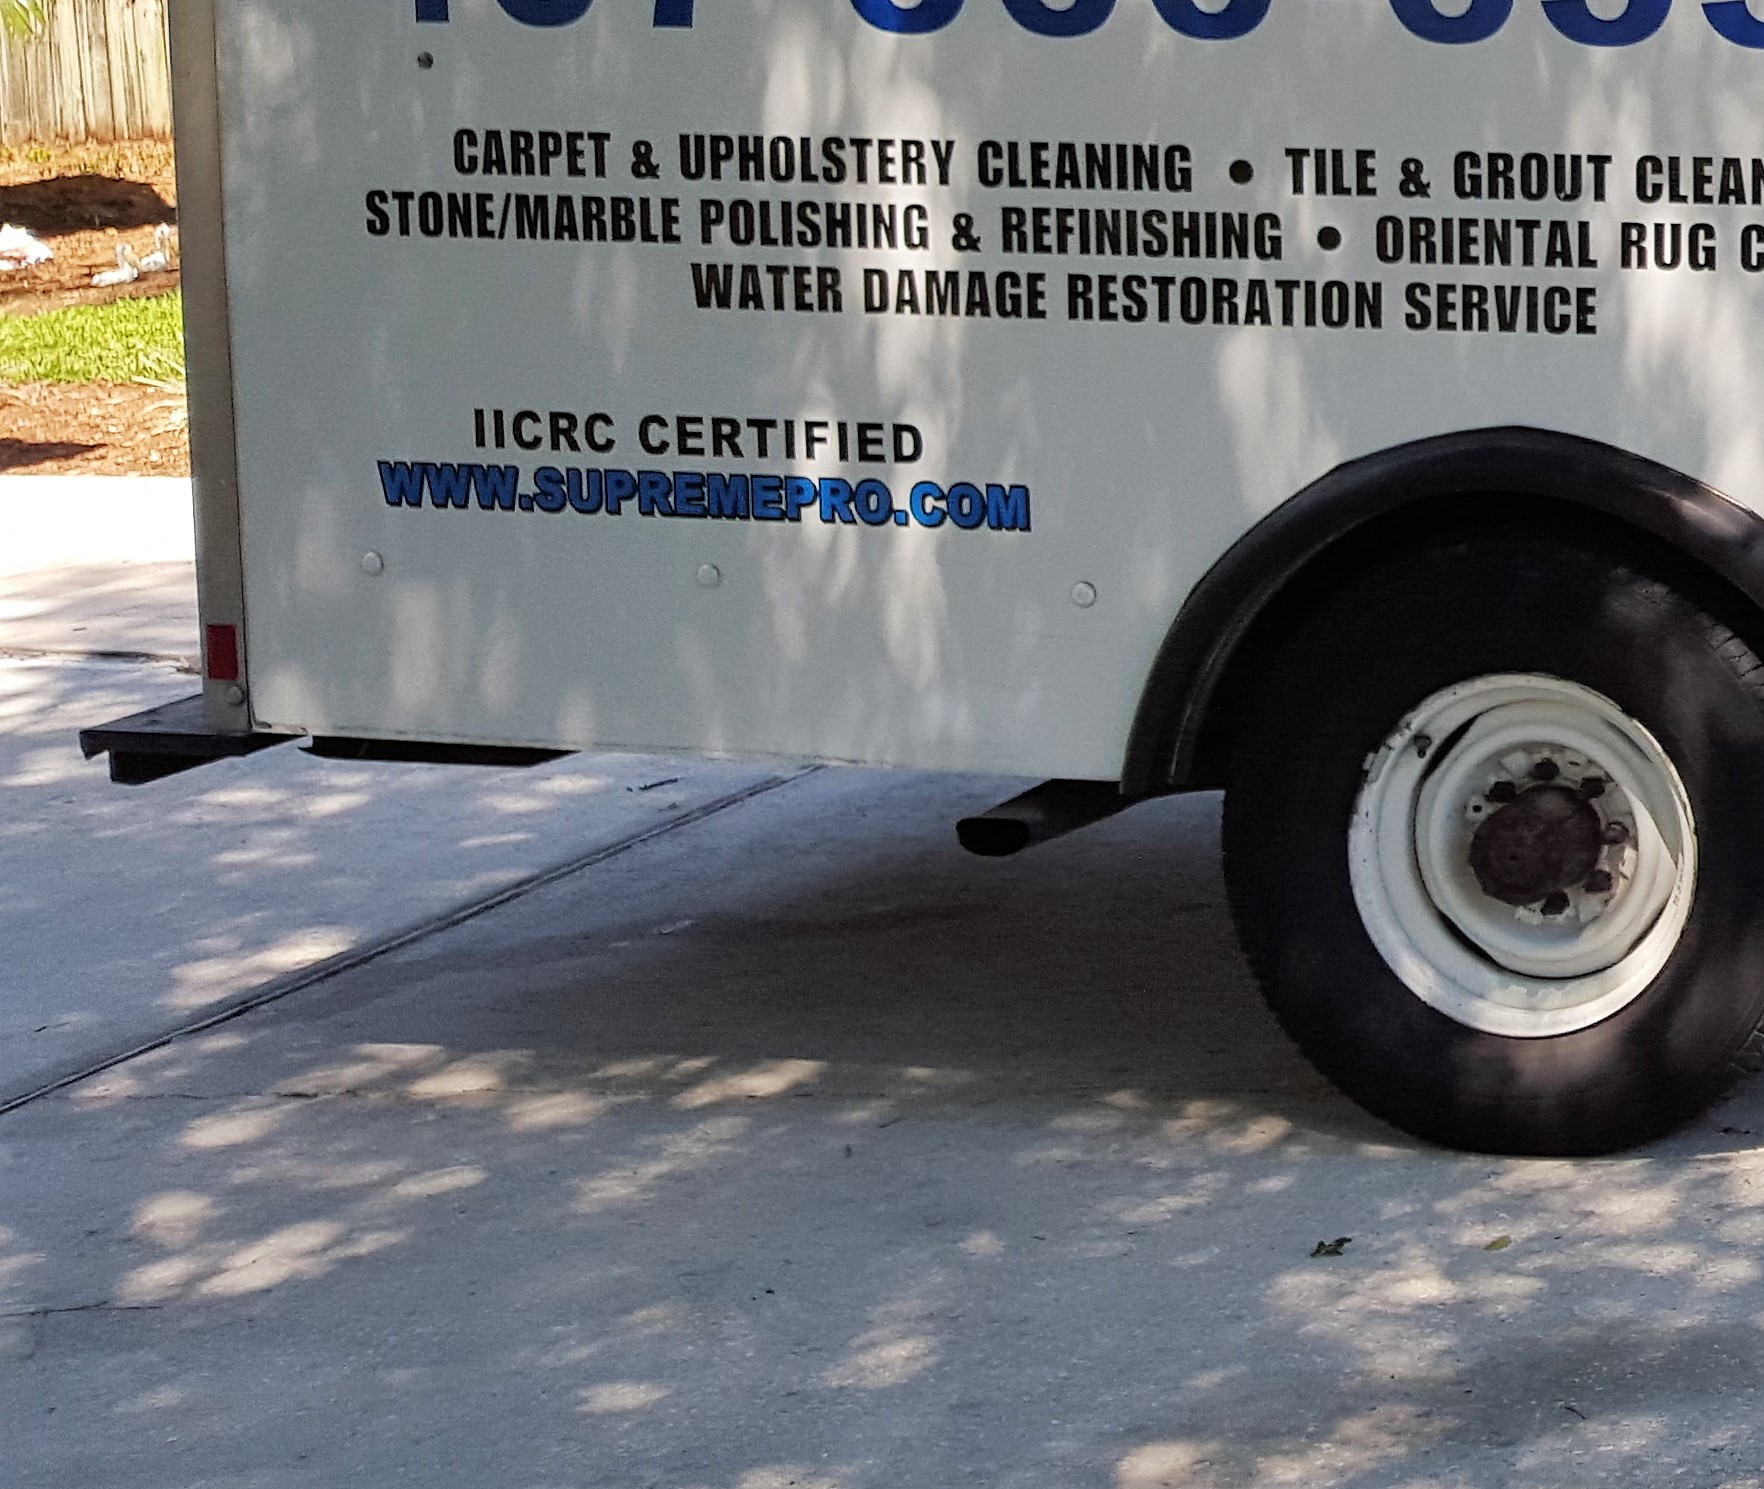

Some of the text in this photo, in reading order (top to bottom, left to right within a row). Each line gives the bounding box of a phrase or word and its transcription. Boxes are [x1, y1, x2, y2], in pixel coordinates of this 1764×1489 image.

[454, 129, 1191, 192] CARPET & UPHOLSTERY CLEANING
[1285, 148, 1377, 196] TILE
[1399, 158, 1430, 198] &
[1454, 151, 1612, 201] GROUT
[366, 190, 1281, 260] STONE/MARBLE POLISHING & REFINISHING
[1376, 216, 1597, 268] ORIENTAL
[1621, 222, 1716, 271] RUG
[690, 263, 1596, 334] WATER DAMAGE RESTORATION SERVICE
[474, 409, 922, 461] IICRC CERTIFIED
[377, 460, 1031, 532] WWW.SUPREMEPRO.COM
